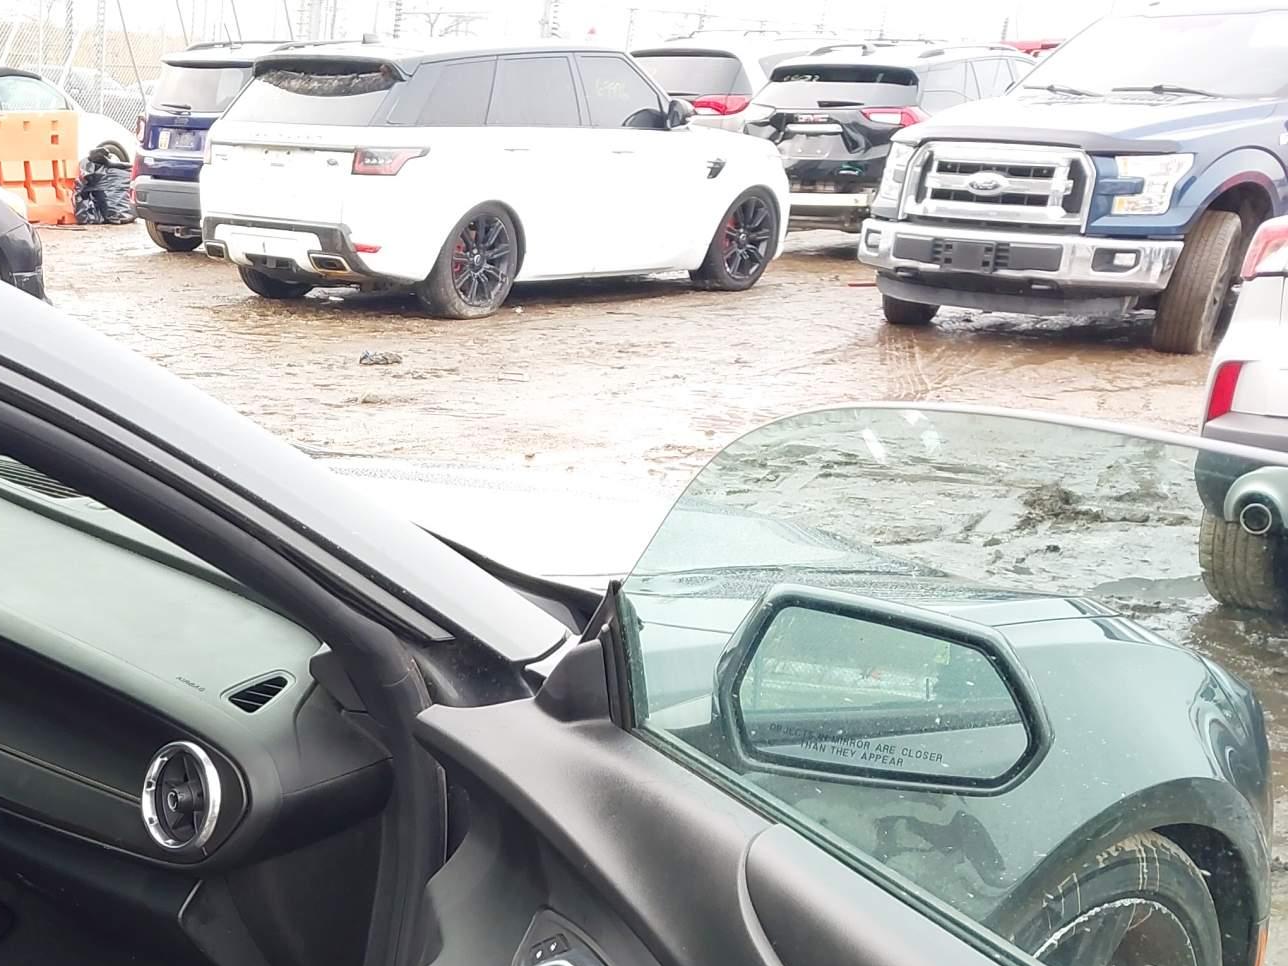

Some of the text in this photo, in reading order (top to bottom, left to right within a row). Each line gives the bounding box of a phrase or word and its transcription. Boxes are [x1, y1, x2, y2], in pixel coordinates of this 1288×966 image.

[799, 741, 905, 767] THAN THEY APPEAR
[831, 736, 872, 751] MIRROR
[875, 743, 896, 755] ARE
[901, 748, 944, 763] CLOSER
